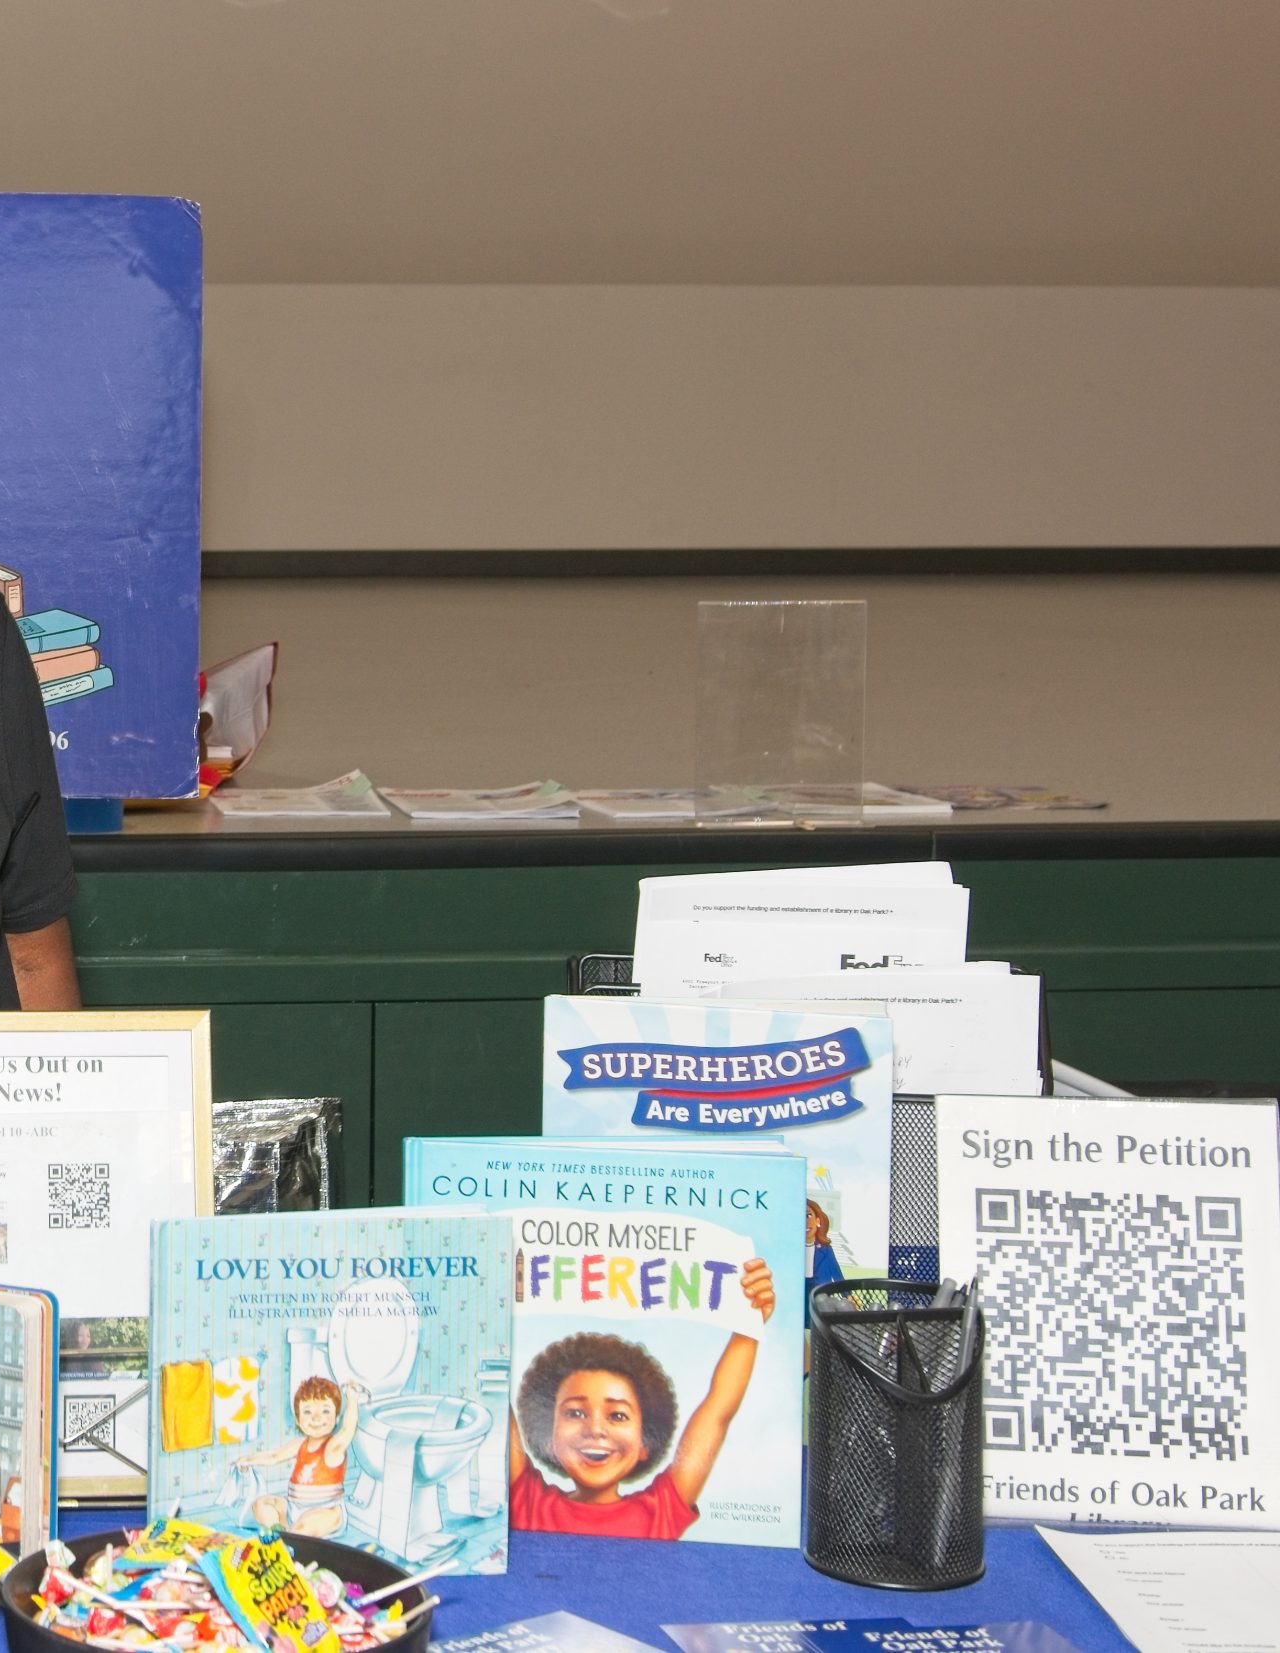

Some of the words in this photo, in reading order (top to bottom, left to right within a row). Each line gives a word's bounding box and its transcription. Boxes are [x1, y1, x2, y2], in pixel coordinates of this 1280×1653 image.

[713, 904, 736, 912] support
[747, 904, 768, 912] funding
[25, 1056, 70, 1075] Out
[76, 1058, 104, 1074] on
[582, 1040, 847, 1082] SUPERHEROES
[646, 1100, 690, 1122] Are
[699, 1090, 848, 1126] Everywhere
[9, 1127, 22, 1138] 10
[961, 1129, 1034, 1168] Sign
[1048, 1132, 1103, 1163] the
[1116, 1133, 1253, 1169] Petition
[487, 1160, 512, 1171] NEW
[517, 1161, 545, 1173] YORK
[551, 1163, 586, 1174] TIMES
[590, 1164, 665, 1178] BESTSELLING
[670, 1168, 715, 1180] AUTHOR
[432, 1175, 536, 1199] COLIN
[556, 1180, 770, 1210] KAEPERNICK
[521, 1219, 599, 1248] COLOR
[608, 1223, 697, 1252] MYSELF
[196, 1258, 270, 1280] LOVE
[279, 1257, 341, 1280] YOU
[351, 1256, 479, 1279] FOREVER
[238, 1292, 299, 1304] WRITTEN
[302, 1292, 318, 1303] BY
[321, 1292, 370, 1303] ROBERT
[374, 1291, 431, 1302] MUNSCH
[228, 1308, 316, 1319] ILLUSTRATED
[318, 1308, 333, 1318] BY
[338, 1307, 382, 1318] SHEILA
[1090, 1480, 1120, 1504] of
[1131, 1482, 1189, 1509] Oak
[1201, 1485, 1267, 1512] Park
[709, 1501, 771, 1513] ILLUSTRATIONS
[773, 1504, 782, 1513] BY
[710, 1511, 729, 1521] ERIC
[731, 1512, 781, 1524] WILKERSON
[250, 1561, 293, 1601] SOUR
[258, 1574, 307, 1623] PATCH
[722, 1621, 818, 1635] Friends
[822, 1620, 848, 1632] of
[863, 1627, 960, 1643] Friends
[964, 1626, 990, 1639] of
[737, 1632, 793, 1644] Oak
[881, 1639, 933, 1651] Oak
[936, 1637, 1005, 1650] Park
